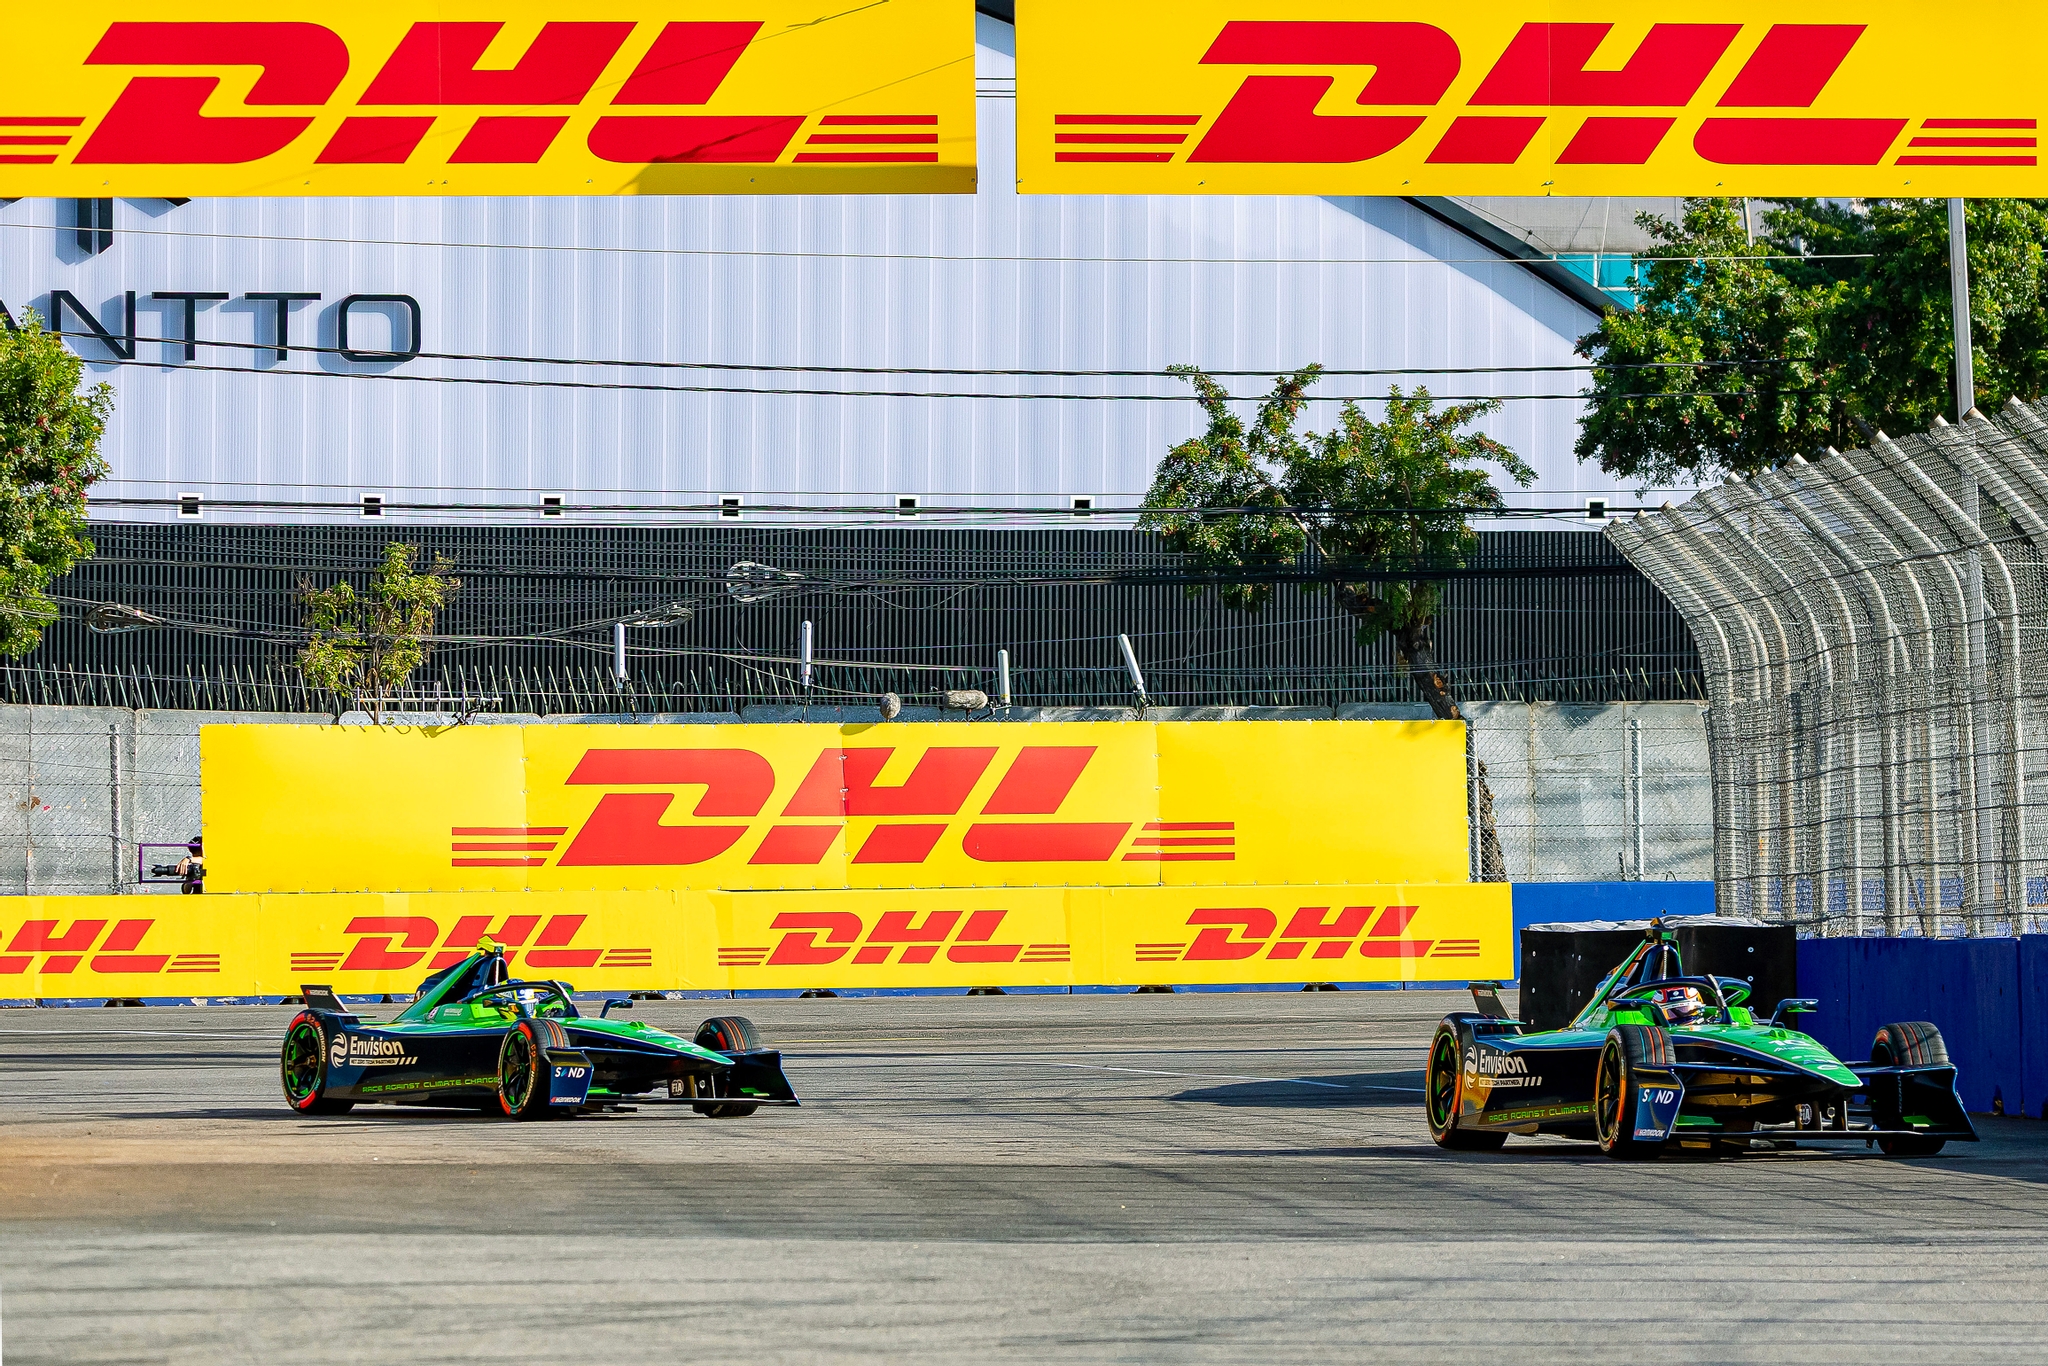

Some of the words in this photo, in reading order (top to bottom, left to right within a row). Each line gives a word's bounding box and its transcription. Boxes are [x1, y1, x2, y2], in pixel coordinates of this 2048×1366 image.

[71, 21, 807, 165] DHL
[1187, 21, 1909, 166] DHL
[0, 290, 422, 363] NTTO
[557, 746, 1133, 867] DHL
[0, 918, 172, 975] HL
[337, 914, 604, 972] DHL
[766, 909, 1024, 967] DHL
[1182, 905, 1435, 961] DHL
[350, 1036, 405, 1056] Envision
[1479, 1049, 1529, 1074] Envision
[362, 1085, 383, 1093] RACE
[385, 1082, 420, 1091] AGAINST
[423, 1079, 462, 1088] CLIMATE
[464, 1077, 499, 1085] CHANGE
[1488, 1113, 1508, 1122] RACE
[1510, 1109, 1546, 1119] AGAINST
[1548, 1105, 1590, 1116] CLIMATE
